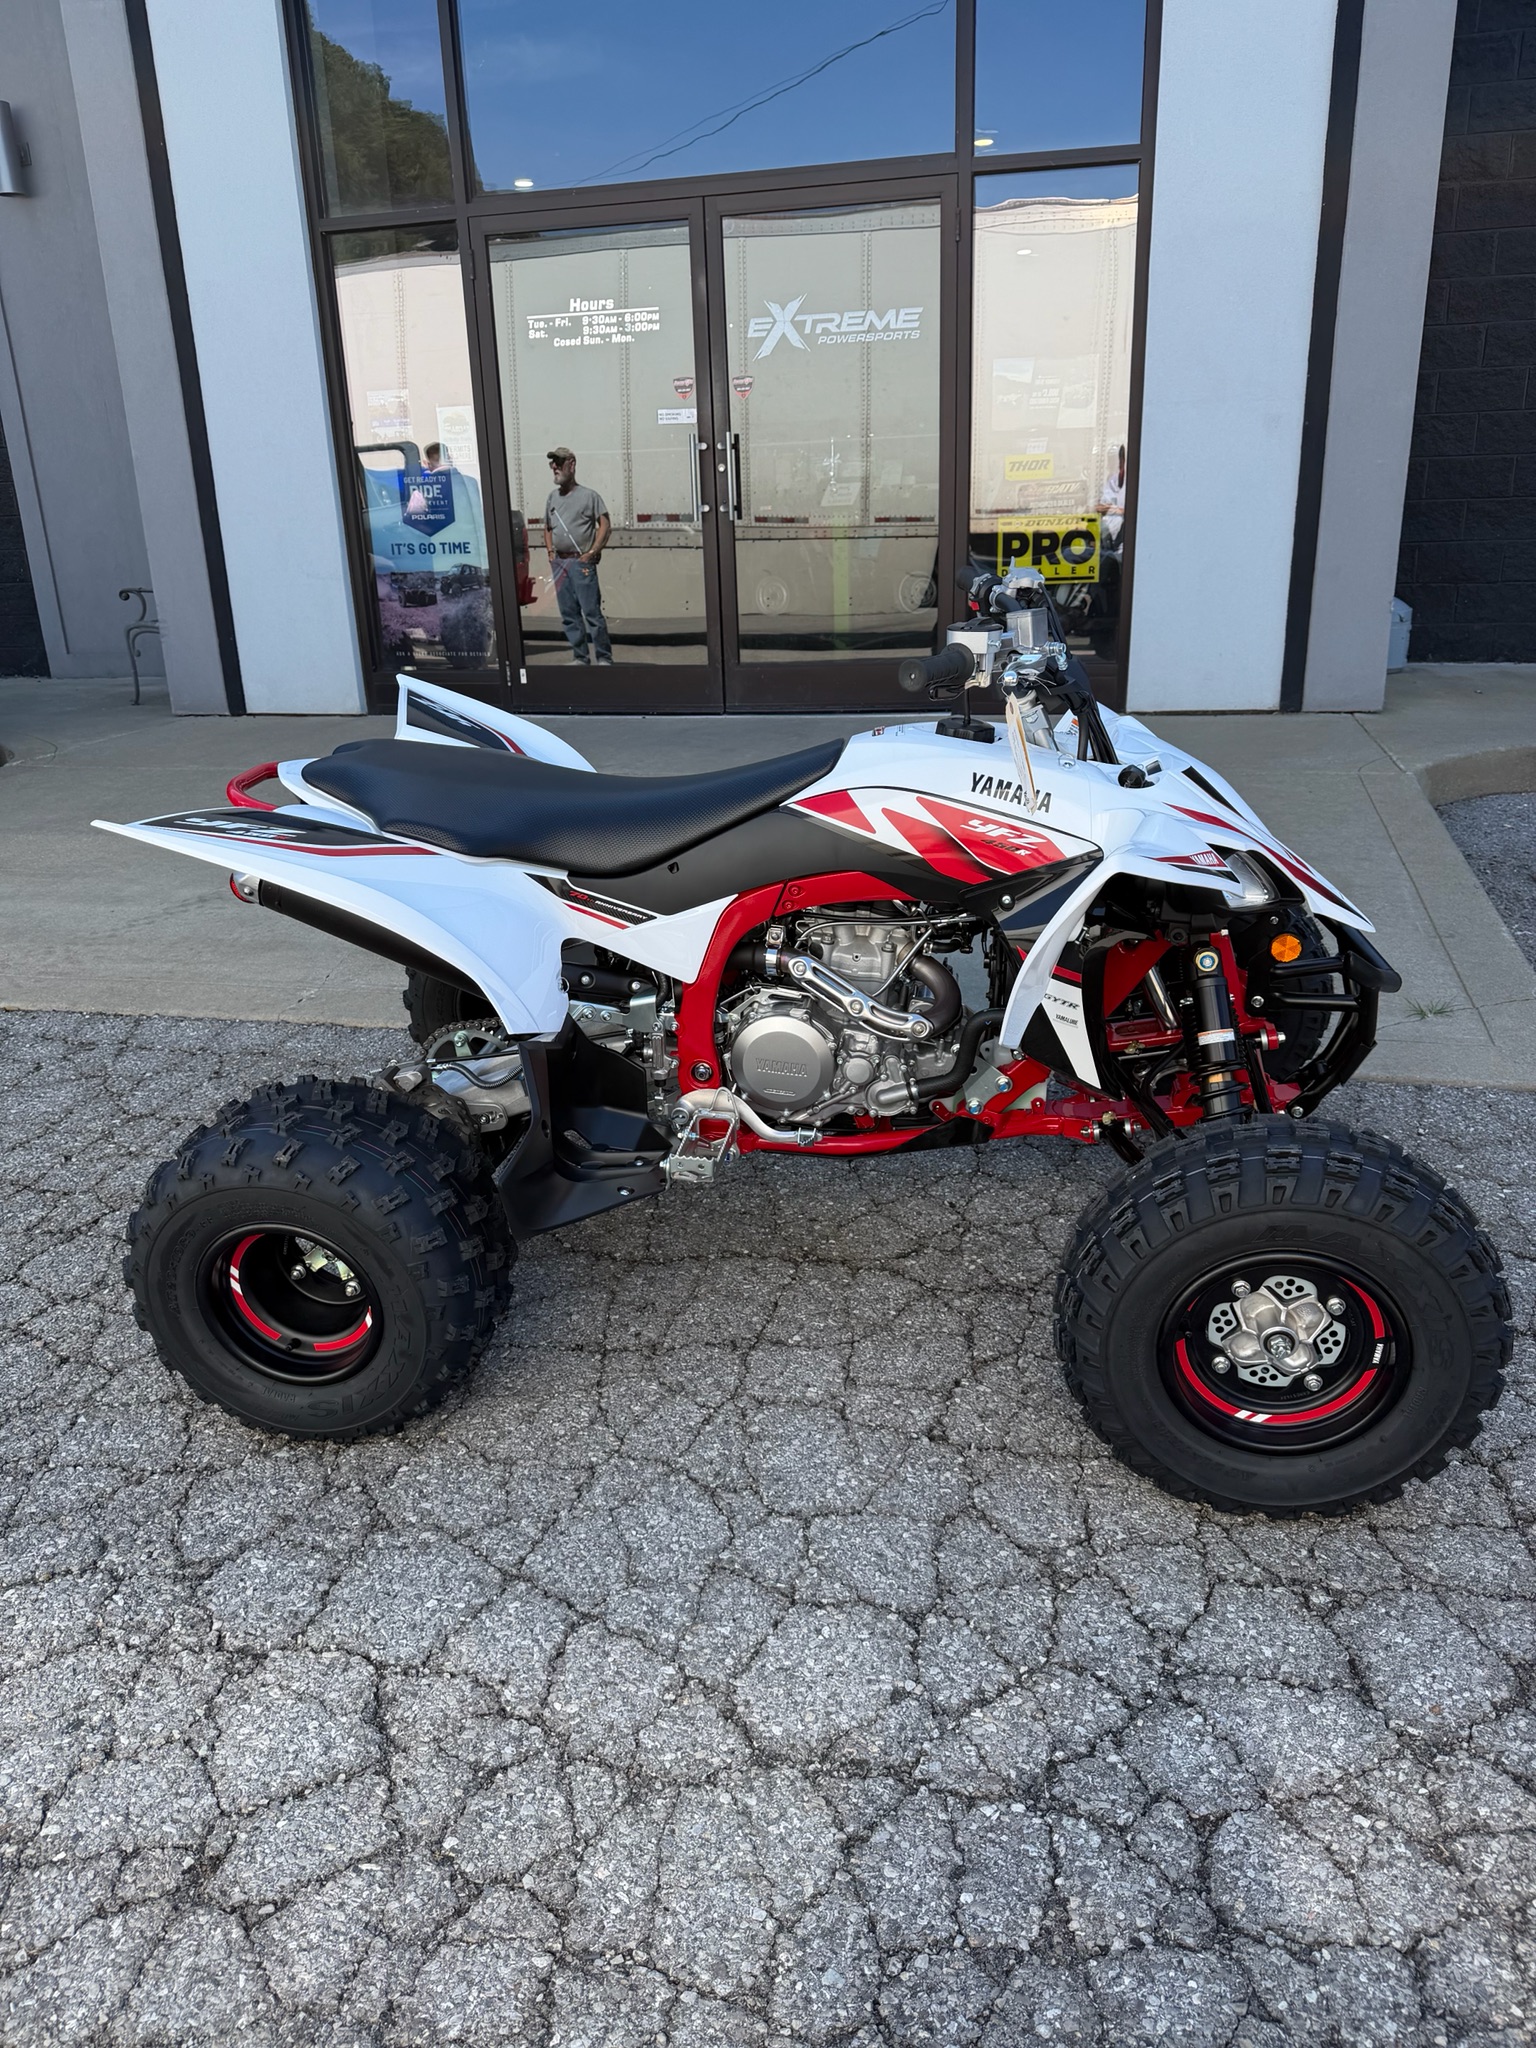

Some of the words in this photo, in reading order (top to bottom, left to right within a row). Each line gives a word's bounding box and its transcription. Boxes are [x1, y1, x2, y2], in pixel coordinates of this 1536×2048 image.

[570, 298, 614, 312] Hours
[527, 319, 547, 329] Tue.
[555, 317, 571, 327] Fri.
[624, 312, 659, 322] 6:00PM
[528, 329, 548, 339] Sat.
[582, 325, 618, 335] 9:30AM
[624, 322, 660, 332] 3:00PM
[817, 330, 920, 345] POWERSPORTS
[553, 336, 581, 347] Cosed
[583, 335, 604, 345] Sun.
[612, 333, 635, 343] Mon.
[1008, 459, 1051, 472] THOR
[404, 476, 416, 484] GET
[416, 476, 437, 484] READY
[391, 543, 416, 556] IT'S
[418, 542, 436, 555] GO
[439, 541, 471, 555] TIME
[1002, 530, 1096, 567] PRO
[1001, 566, 1095, 577] DALER
[1189, 852, 1219, 866] YAMAHA
[1043, 993, 1080, 1010] GYTR
[1055, 1013, 1079, 1026] YAMALUBE
[755, 1057, 808, 1078] YAMAHA
[1371, 1343, 1384, 1364] YAMAHA
